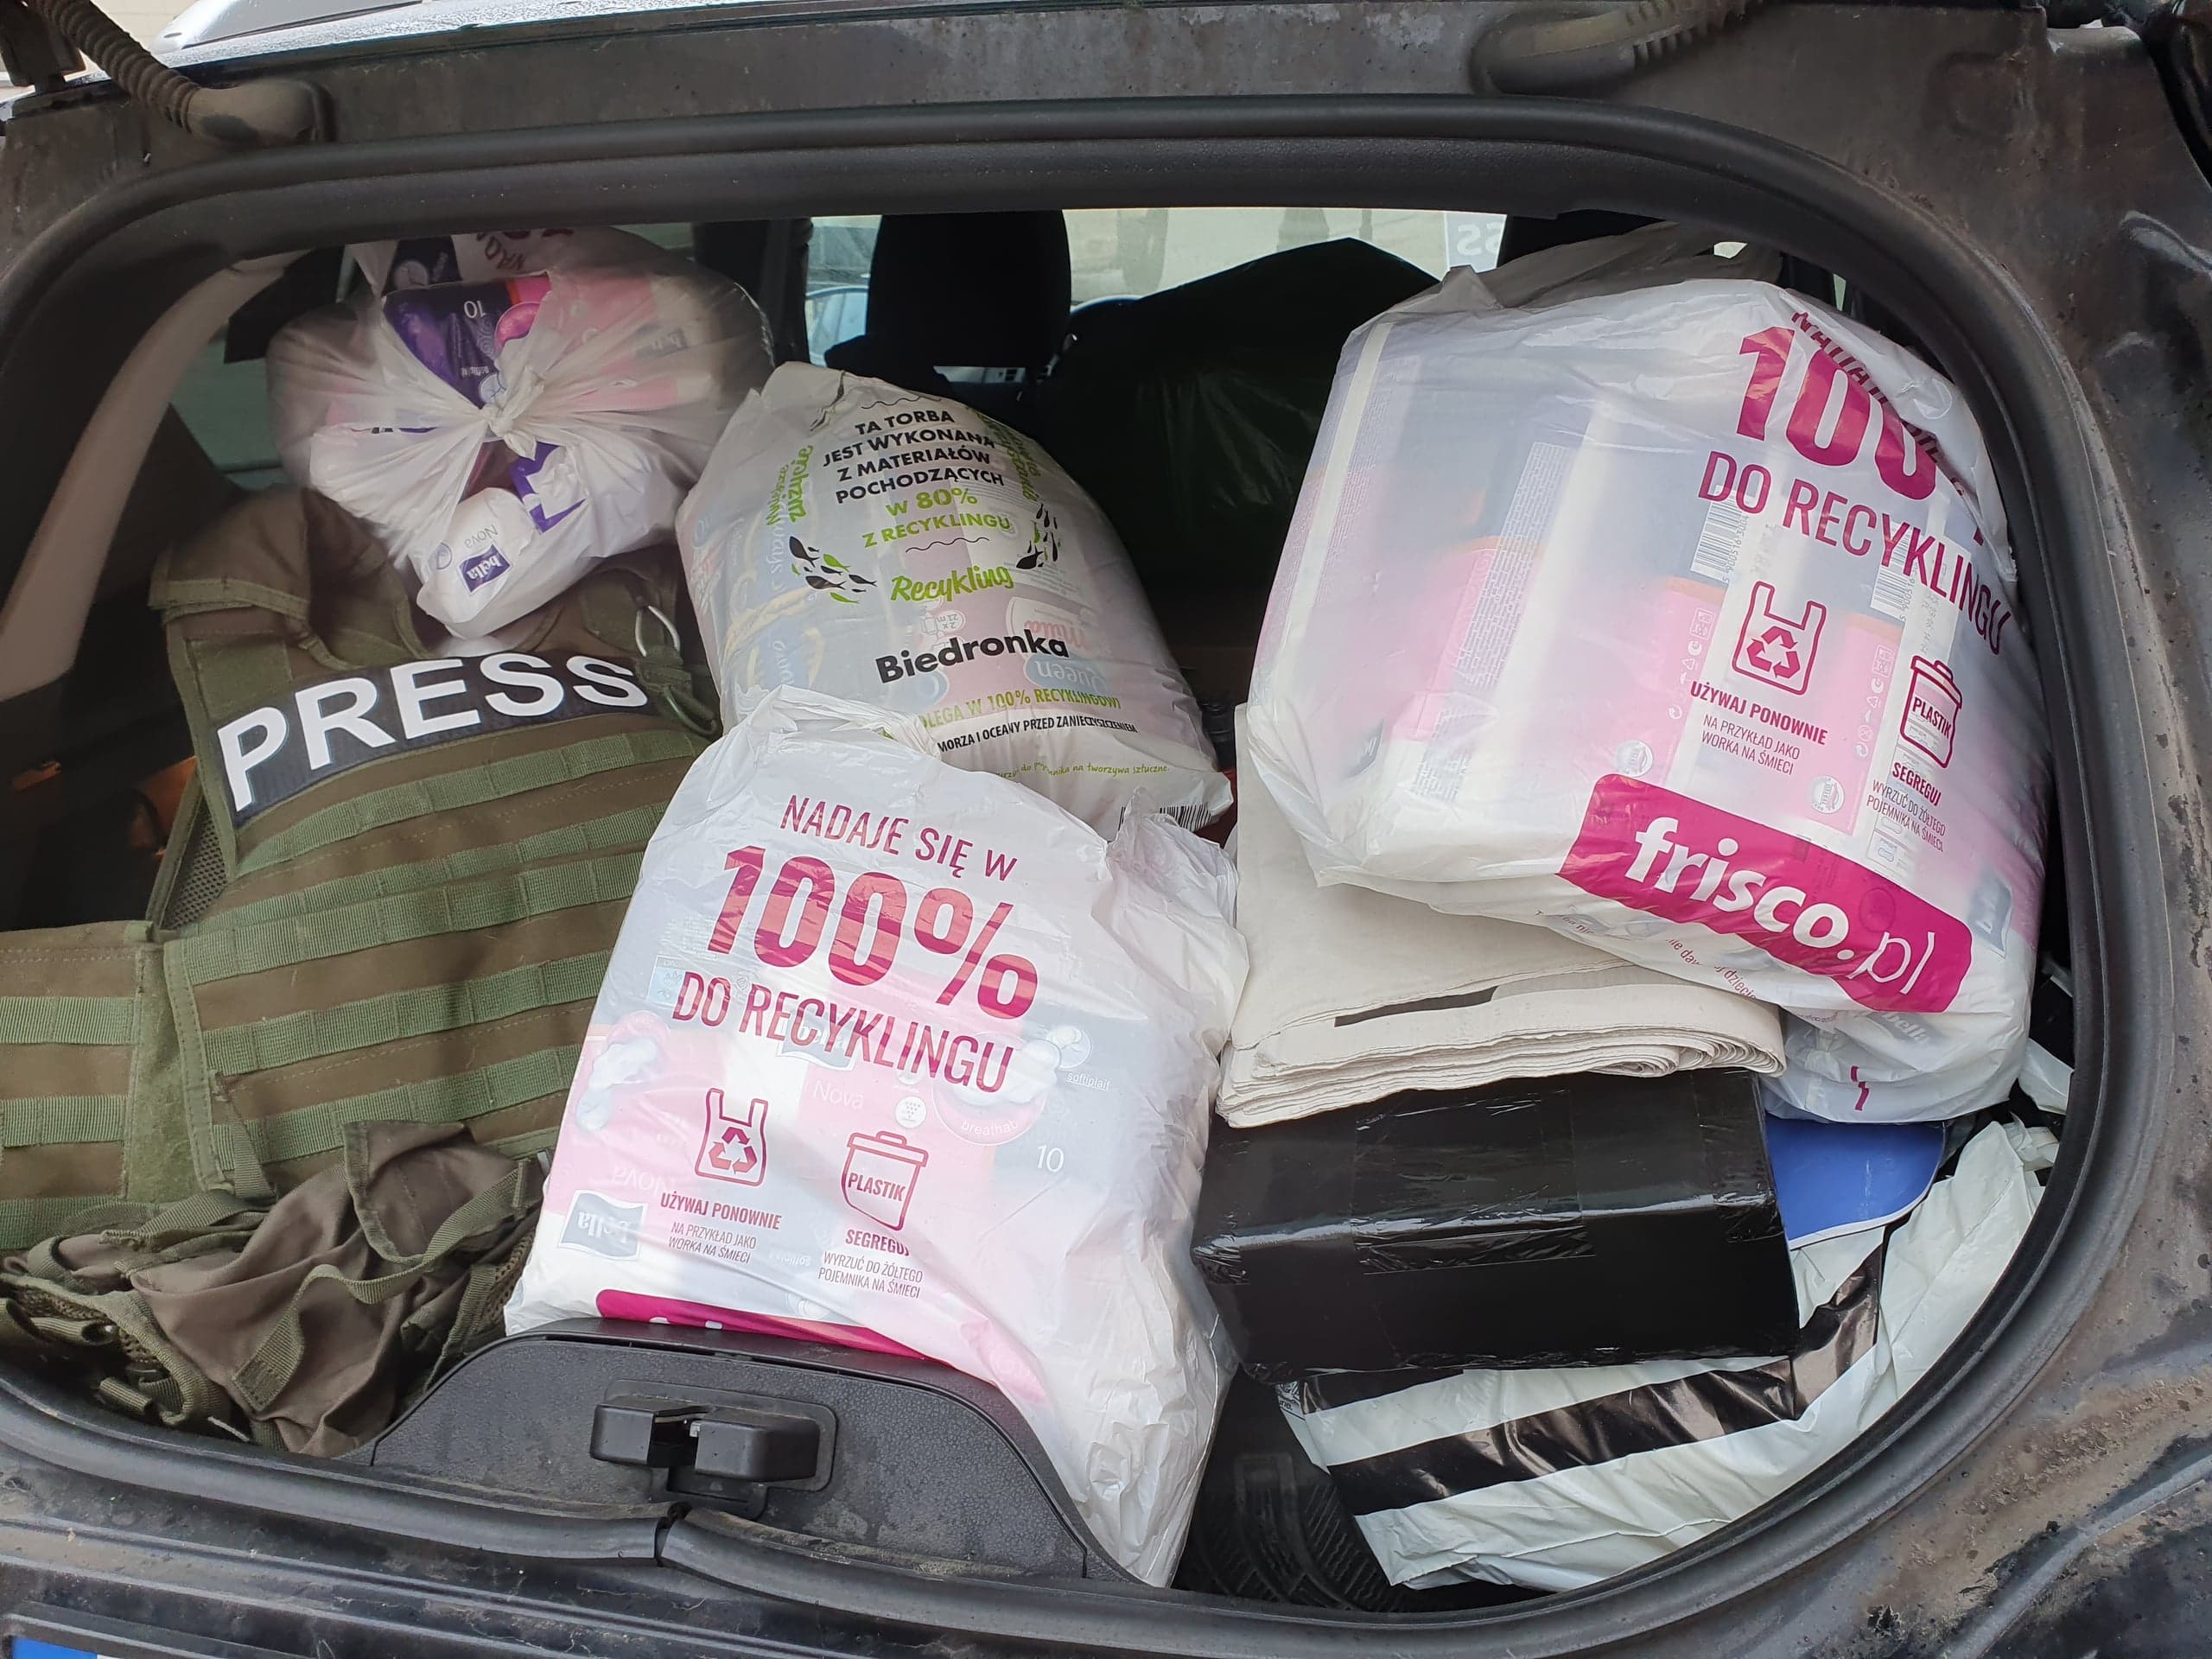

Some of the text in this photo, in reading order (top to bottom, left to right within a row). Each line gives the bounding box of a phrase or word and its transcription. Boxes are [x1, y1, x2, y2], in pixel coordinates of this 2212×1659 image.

[464, 300, 486, 319] 10
[855, 409, 956, 435] TA TORBA
[1736, 326, 1938, 501] 100
[823, 442, 863, 467] JEST
[868, 429, 996, 452] WYKONANA
[836, 466, 853, 482] Z
[857, 444, 991, 477] MATERIAŁÓW
[835, 467, 1005, 505] POCHODZĄCYCH
[914, 486, 978, 510] 80%
[464, 524, 499, 550] Nova
[861, 512, 1012, 550] Z RECYKLINGU
[466, 553, 503, 581] bella
[1698, 450, 1772, 514] DO
[1783, 478, 2012, 656] RECYKLINGU
[890, 564, 1014, 603] Recykling
[874, 628, 1070, 684] Biedronka
[965, 698, 983, 716] W
[988, 690, 1030, 712] 100%
[1035, 688, 1122, 709] RECYKLINGOWI
[1690, 681, 1828, 746] UŻYWAJ PONOWNIE
[1911, 696, 1952, 740] PLASTIK
[217, 652, 649, 813] PRESS
[937, 733, 976, 753] MORZA
[982, 721, 1021, 741] OCEANY
[1023, 718, 1056, 734] PRZED
[1703, 714, 1801, 760] NA PRZYKŁAD JAKO
[1087, 762, 1130, 778] tworzywa
[1701, 729, 1795, 776] WORKA NA ŚMIECI
[1891, 761, 1942, 807] SEGREGUJ
[1866, 793, 1911, 830] POJEMNIKA
[1910, 819, 1922, 838] NA
[1921, 824, 1944, 854] ŚMIECI
[1872, 779, 1909, 810] WYRZUĆ
[1906, 798, 1919, 817] DO
[1918, 801, 1947, 838] ŻÓŁTEGO
[780, 795, 1018, 881] NADAJE SIĘ W
[1624, 817, 1936, 995] frisco.pl
[707, 845, 1039, 1020] 100%
[671, 970, 732, 1027] DO
[739, 983, 1015, 1094] RECYKLINGU
[812, 1080, 865, 1109] Nova
[1037, 1144, 1065, 1173] 10
[848, 1172, 906, 1202] PLASTIK
[659, 1191, 782, 1230] UŻYWAJ PONOWNIE
[668, 1236, 751, 1264] WORKA NA ŚMIECI
[671, 1221, 757, 1249] NA PRZYKŁAD JAKO
[817, 1267, 921, 1299] POJEMNIKA NA ŚMIECI
[823, 1250, 923, 1283] WYRZUĆ DO ŻÓŁTEGO
